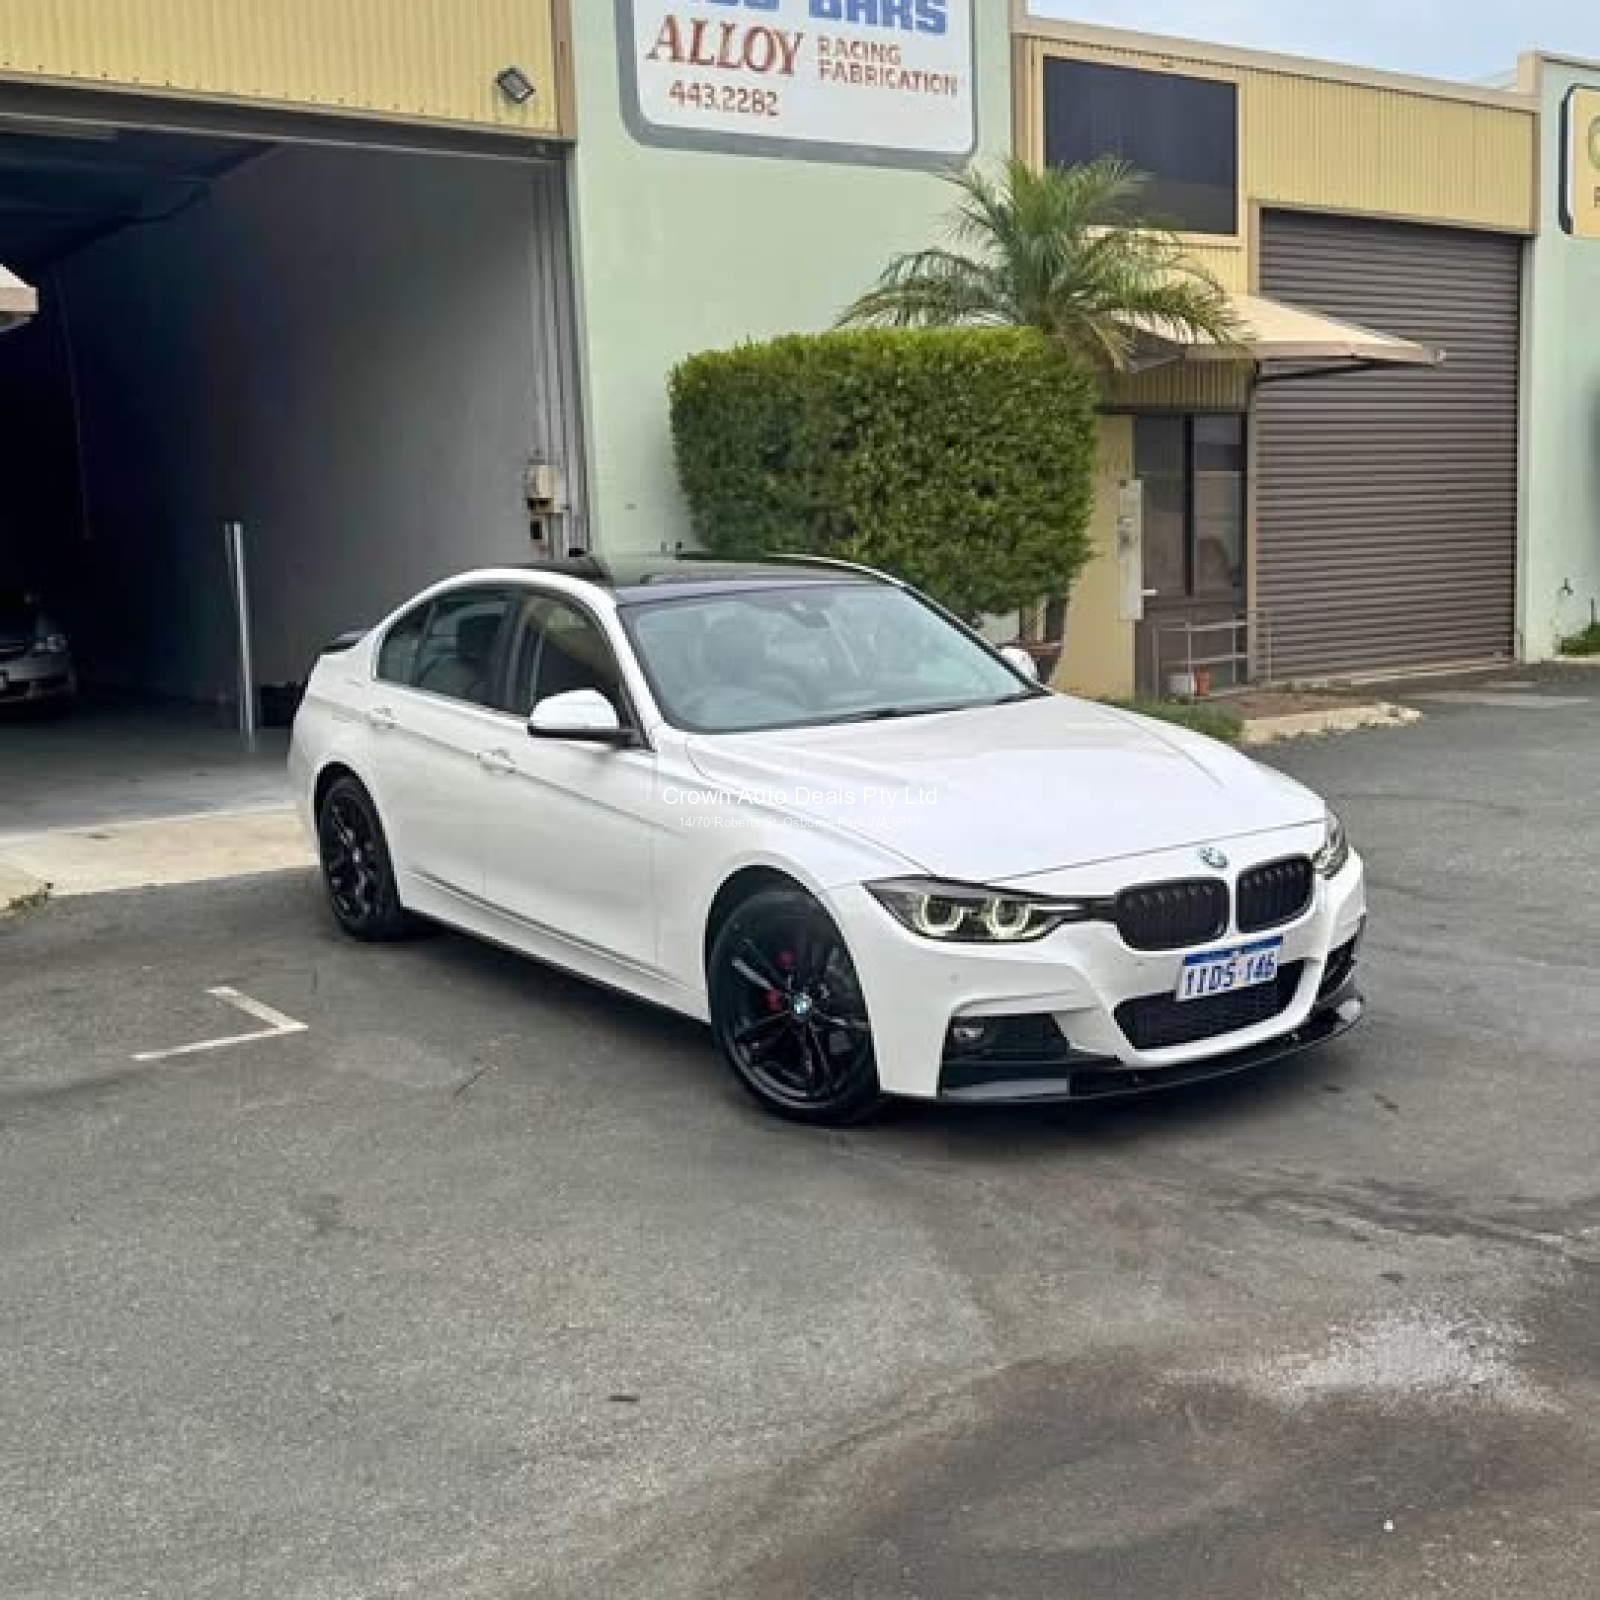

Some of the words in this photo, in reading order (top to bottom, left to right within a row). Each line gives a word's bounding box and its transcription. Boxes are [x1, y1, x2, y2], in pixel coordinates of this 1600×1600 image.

[645, 14, 804, 75] ALLOY
[817, 36, 901, 66] RACING
[818, 59, 958, 96] FABRICATION
